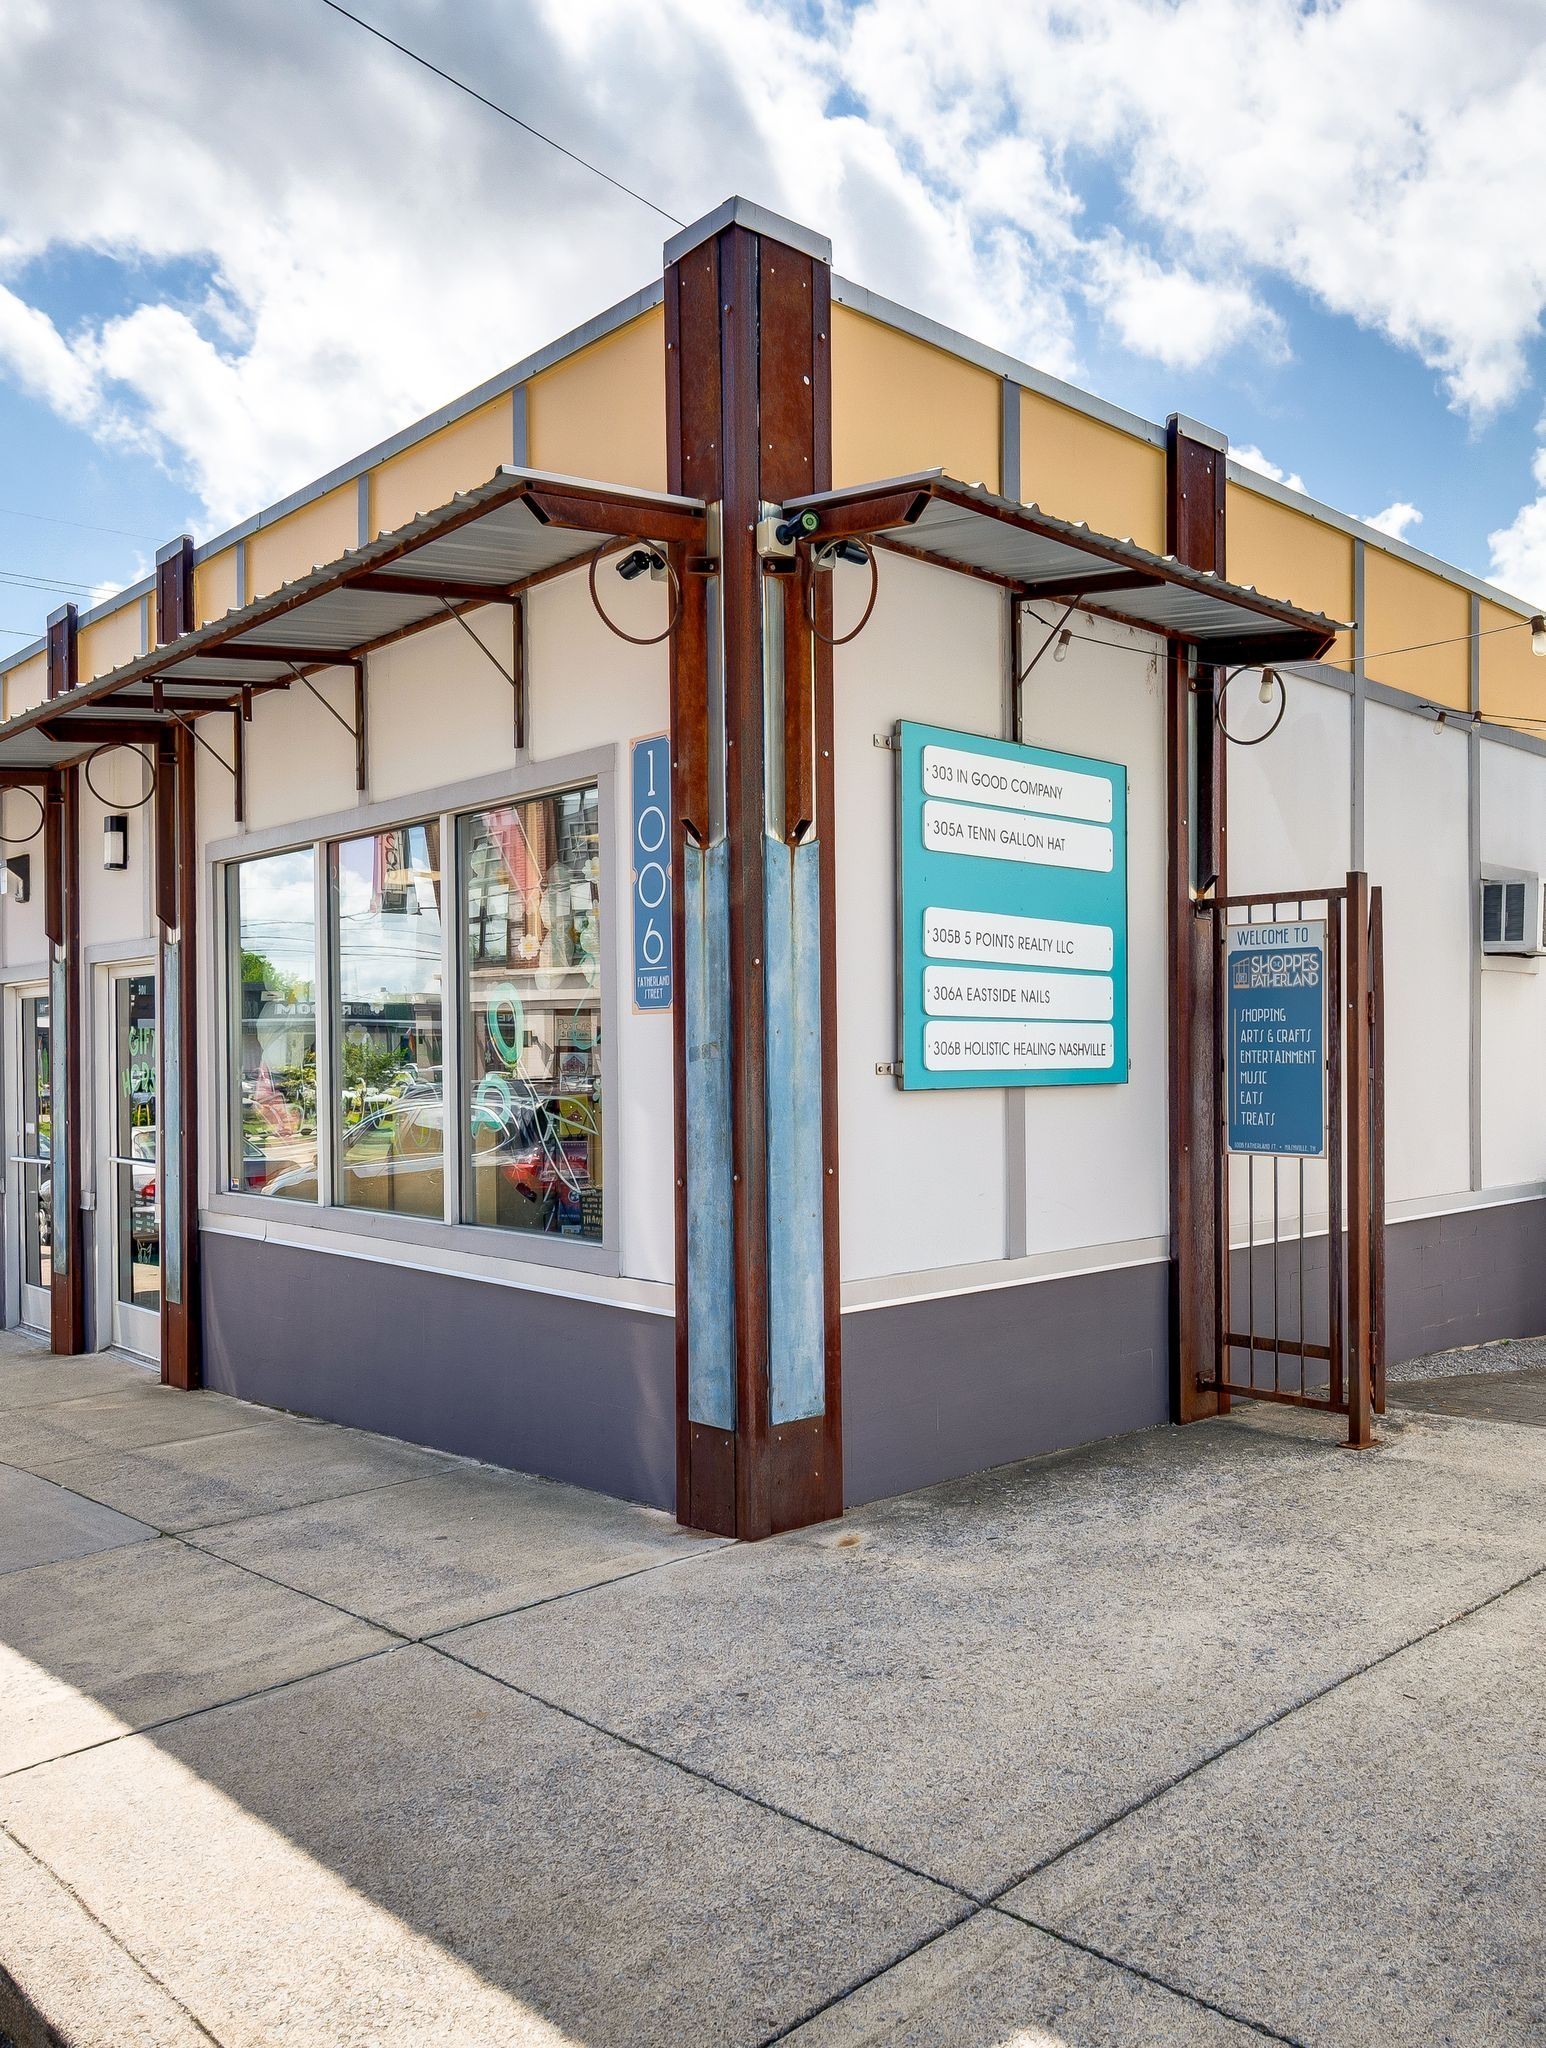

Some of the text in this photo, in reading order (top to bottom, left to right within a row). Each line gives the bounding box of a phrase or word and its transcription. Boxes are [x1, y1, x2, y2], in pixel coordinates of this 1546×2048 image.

[932, 765, 1063, 799] 303 IN GOOD COMPANY
[933, 820, 1066, 851] 305A TENN GALLON HAT
[637, 749, 667, 965] 1006
[932, 927, 1075, 954] 305B 5 POINTS REALTY LLC
[1237, 927, 1309, 946] WELCOME TO
[1251, 953, 1320, 974] SHOPPES
[637, 975, 670, 988] FATHERLAND
[1251, 972, 1319, 988] FATHERLAND
[644, 988, 663, 999] STREET
[933, 986, 1051, 1004] 306A EASTSIDE NAILS
[1240, 1008, 1286, 1022] SHOPPING
[1240, 1028, 1312, 1043] ARTS & CRAFTS
[933, 1041, 1106, 1056] 306B HOLISTIC HEALING NASHVILLE
[1240, 1049, 1317, 1064] ENTERTAINMENT
[1240, 1070, 1268, 1085] MUSIC
[1240, 1091, 1264, 1105] EATS
[1240, 1111, 1276, 1126] TREATS
